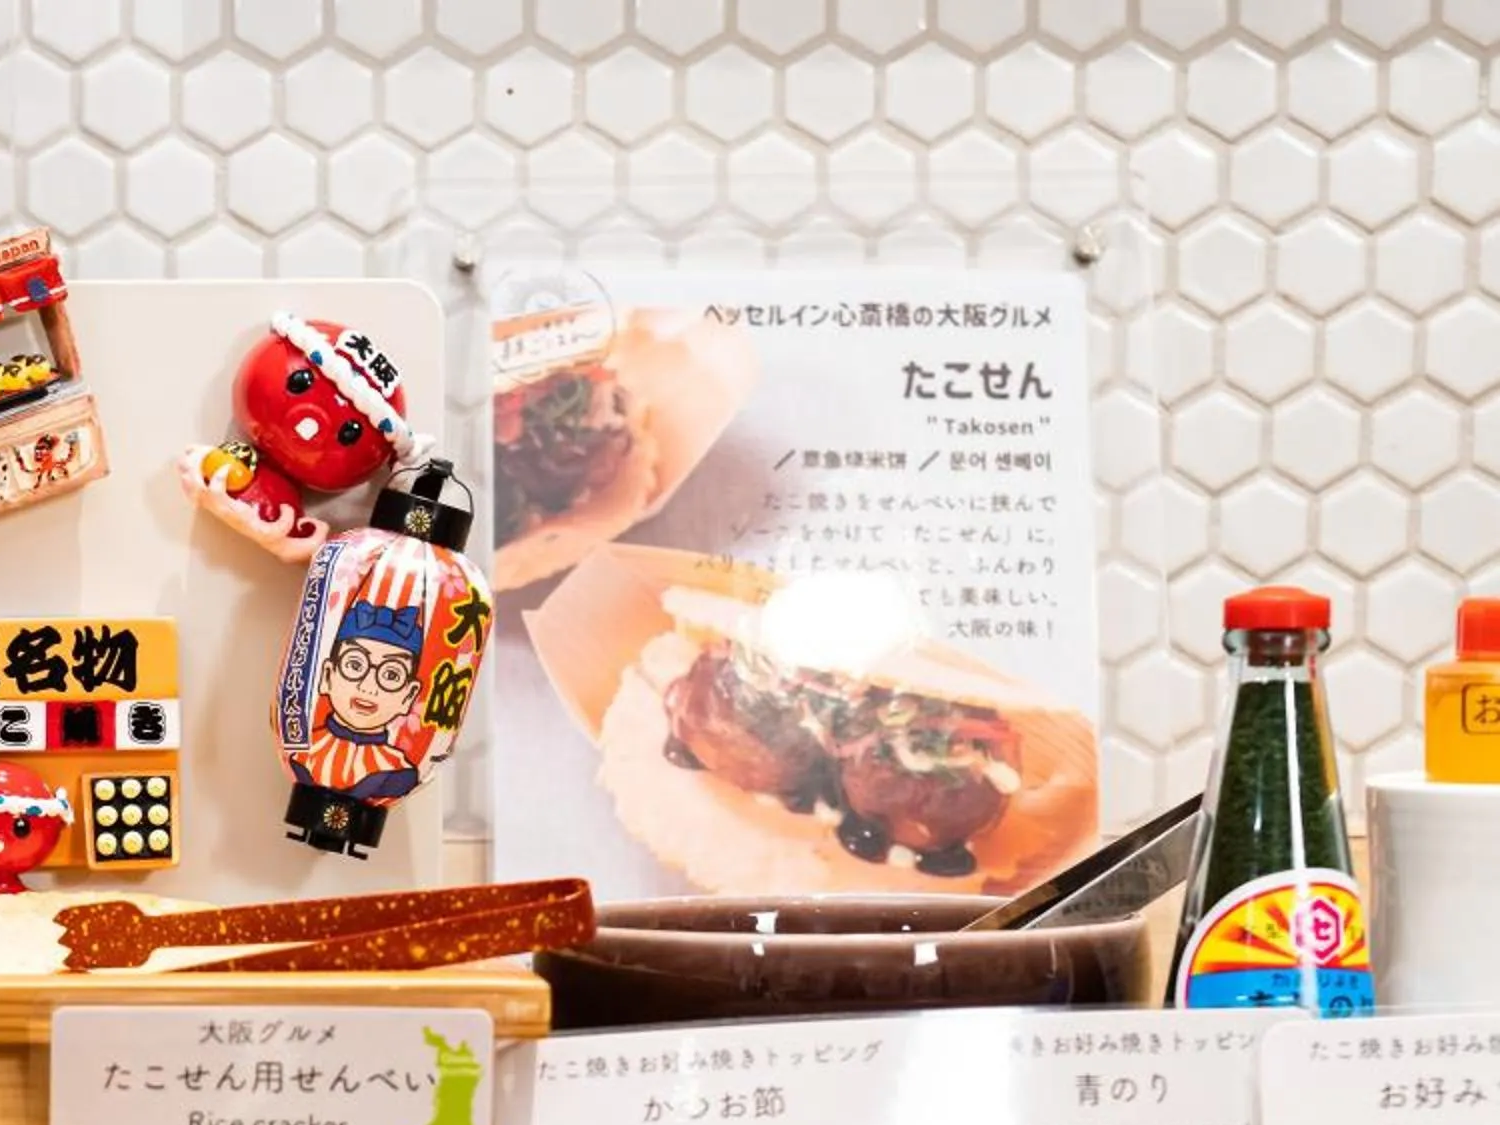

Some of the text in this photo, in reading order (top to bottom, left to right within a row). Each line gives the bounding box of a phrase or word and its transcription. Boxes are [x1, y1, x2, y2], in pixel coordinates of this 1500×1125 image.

[344, 333, 399, 389] 大阪
[902, 360, 1053, 400] たこせん
[198, 1019, 337, 1046] 大阪グルメ
[103, 1061, 437, 1096] たこせん用せんべい
[1075, 1073, 1169, 1108] 青のり
[642, 1085, 787, 1123] かつお節
